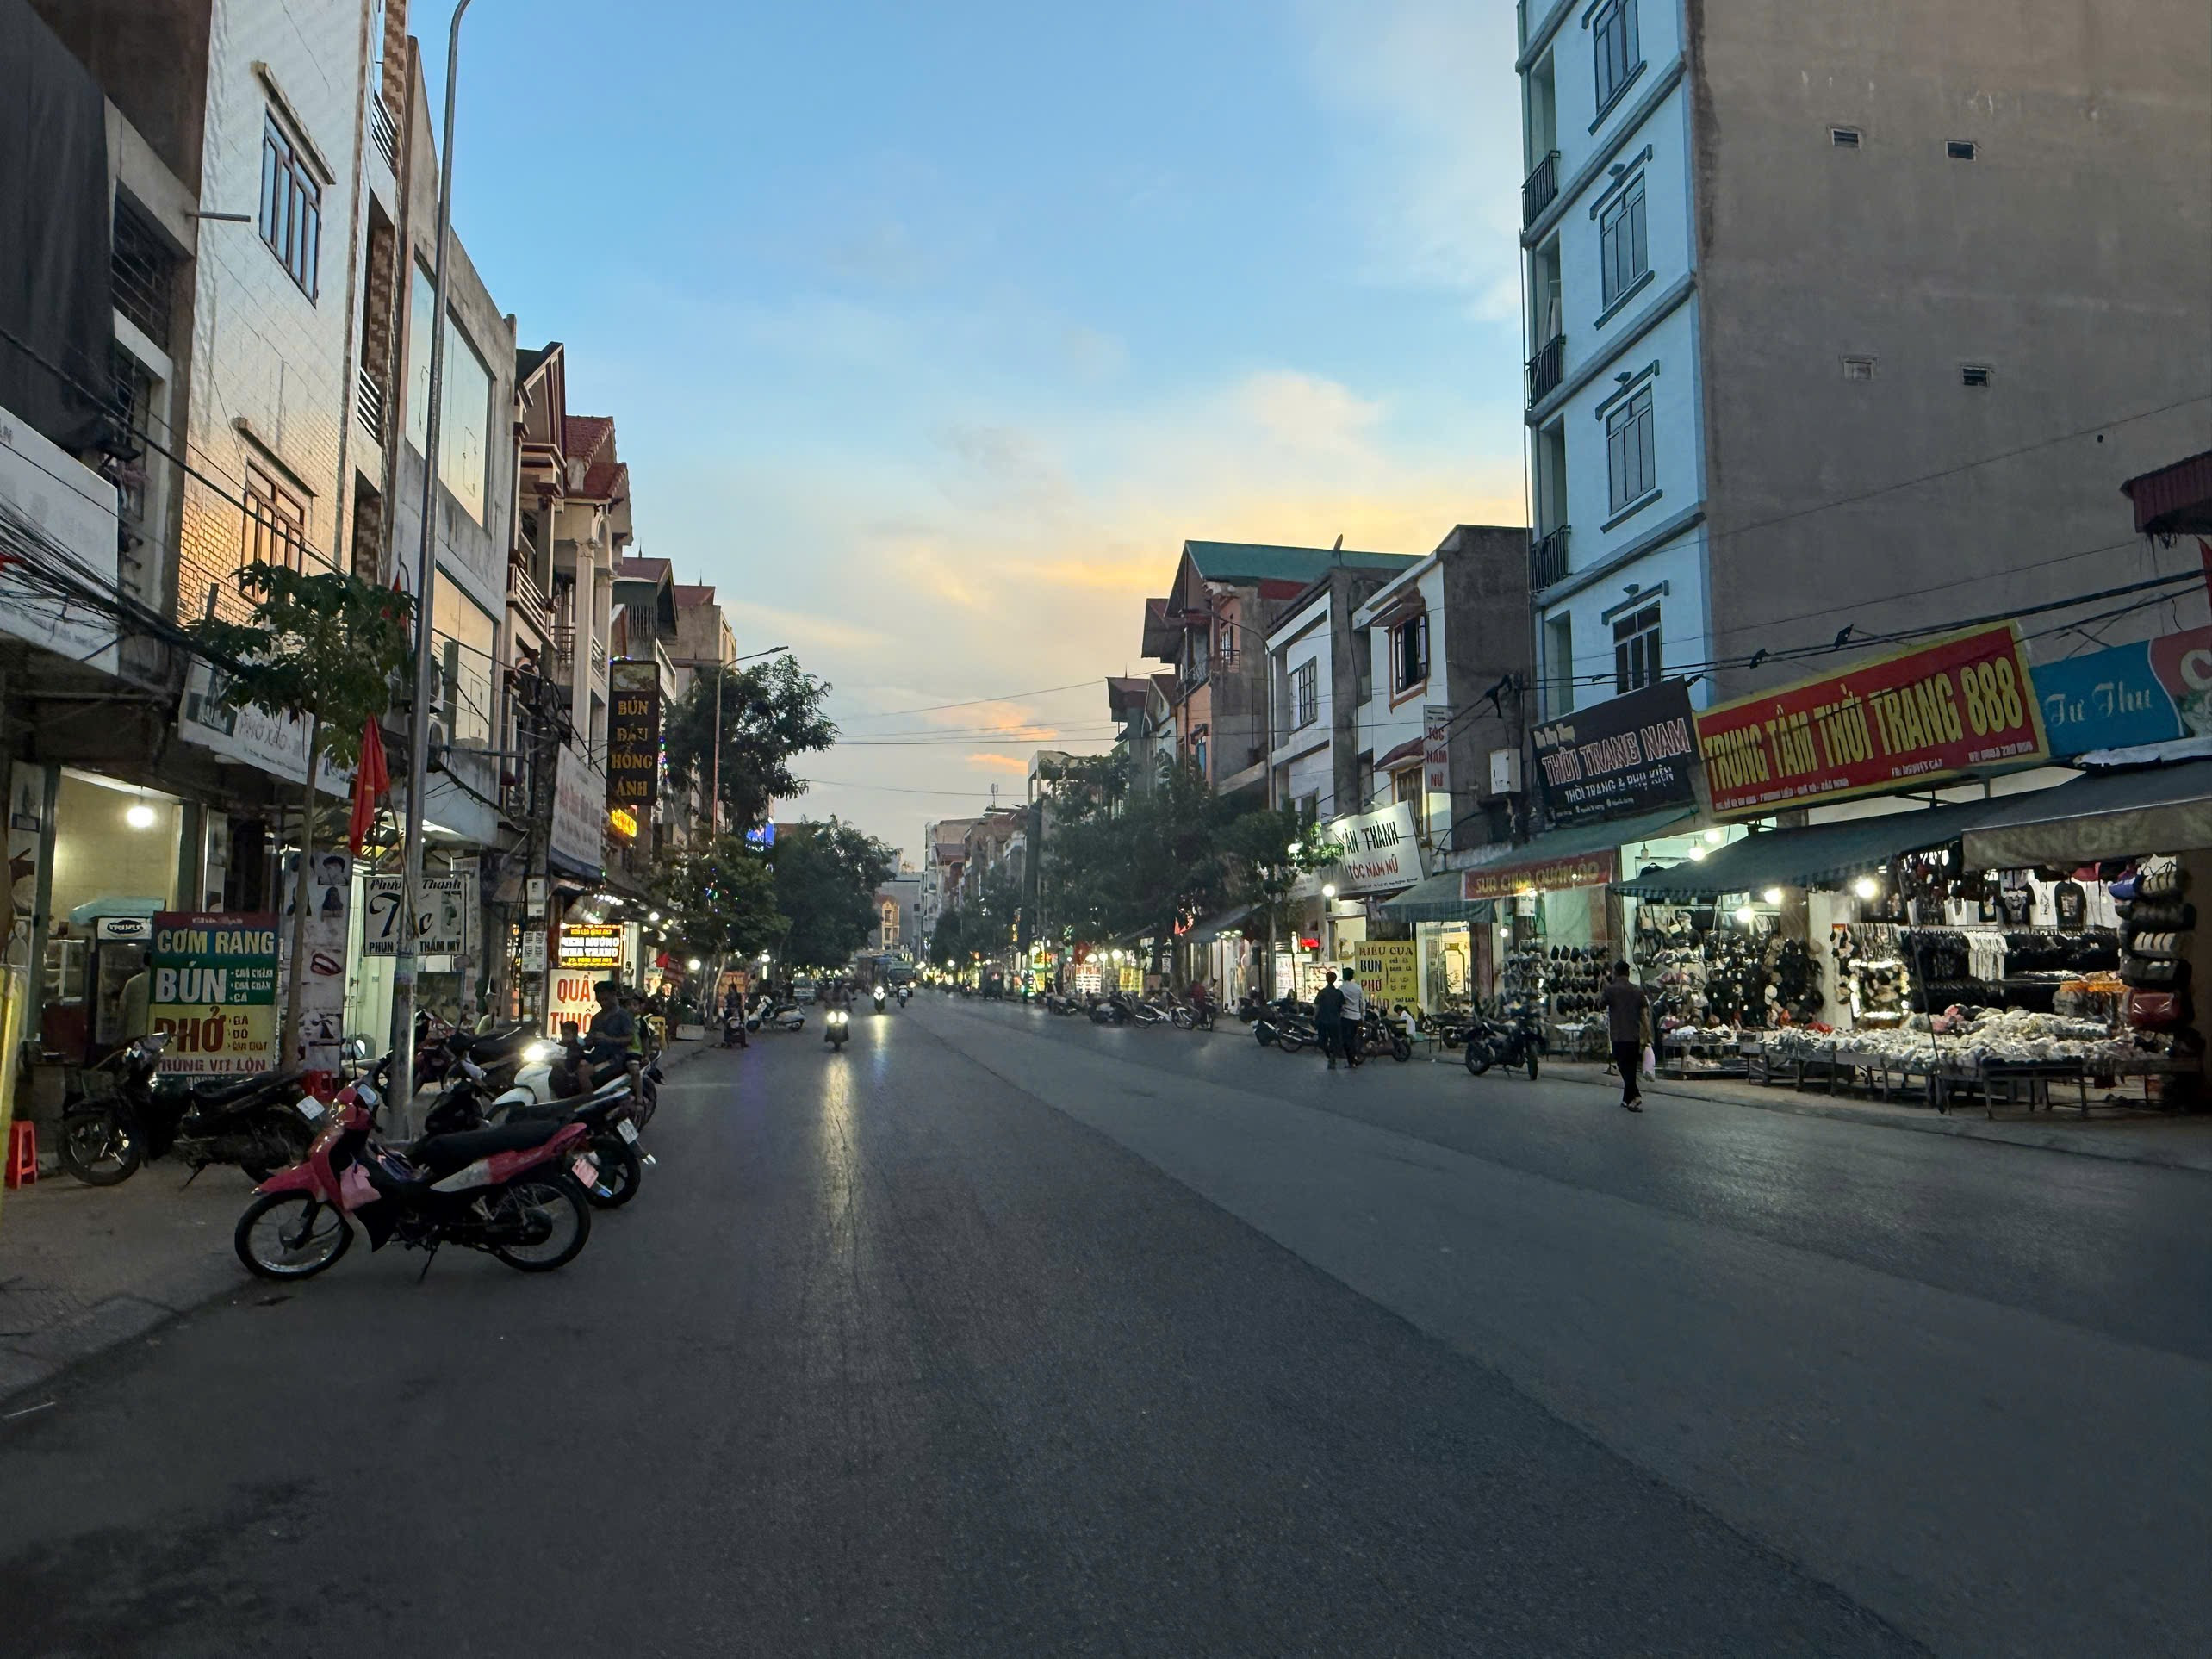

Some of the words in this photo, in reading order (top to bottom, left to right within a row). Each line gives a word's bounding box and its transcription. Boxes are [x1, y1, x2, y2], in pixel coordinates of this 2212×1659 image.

[618, 695, 649, 716] BÚN
[1703, 724, 1770, 791] TRUNG
[1764, 704, 1819, 778] TÂM
[1813, 683, 1873, 768] THỜI
[1867, 672, 1964, 755] TRANG
[1960, 656, 2023, 736] 888
[611, 742, 653, 769] HỒNG
[1541, 746, 1582, 786] THỜI
[1579, 731, 1642, 777] TRANG
[1640, 717, 1692, 762] NAM
[616, 775, 648, 797] ÁNH
[1585, 777, 1617, 798] TRANG
[1360, 819, 1400, 852] THÀNH
[1365, 861, 1386, 878] NAM
[157, 928, 208, 955] CƠM
[215, 930, 275, 955] RANG
[369, 941, 394, 953] PHUN
[155, 960, 227, 1003] BÚN
[153, 1005, 227, 1053] PHỞ
